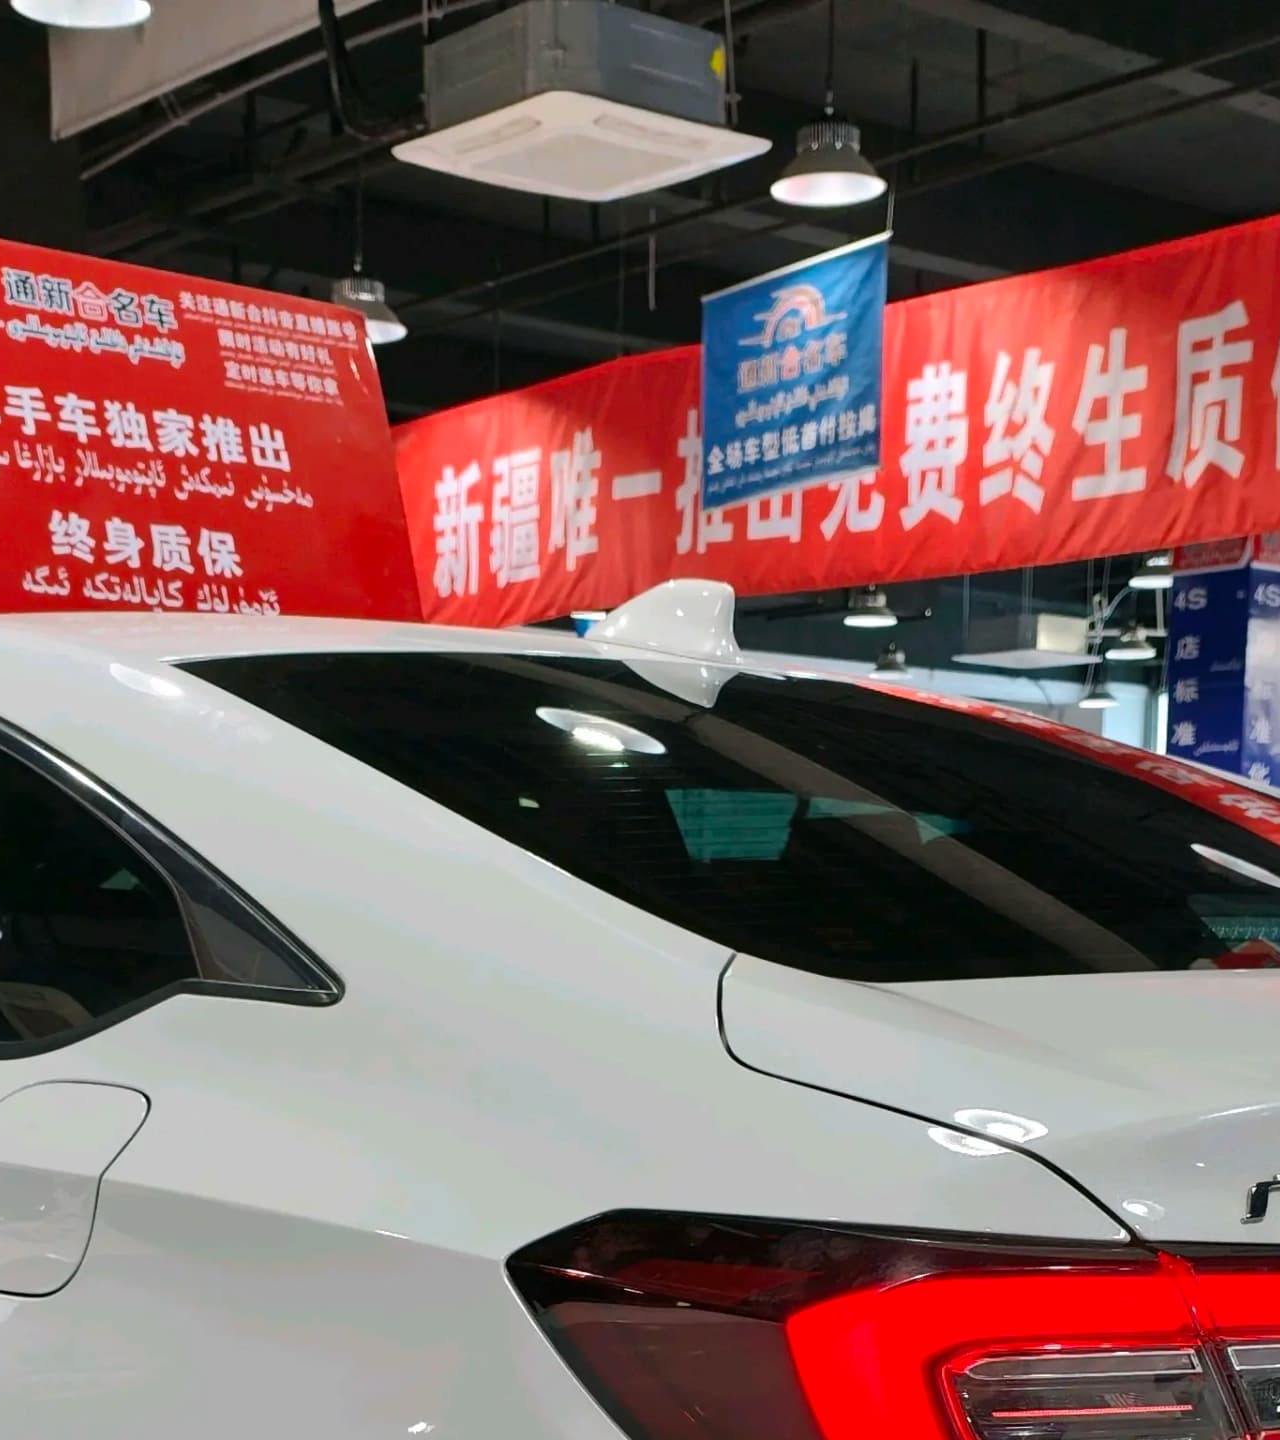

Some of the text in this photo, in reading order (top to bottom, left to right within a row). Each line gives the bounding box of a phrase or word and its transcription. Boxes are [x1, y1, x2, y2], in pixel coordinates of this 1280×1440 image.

[1, 267, 178, 332] 通新合名车
[48, 509, 244, 578] 终身质保
